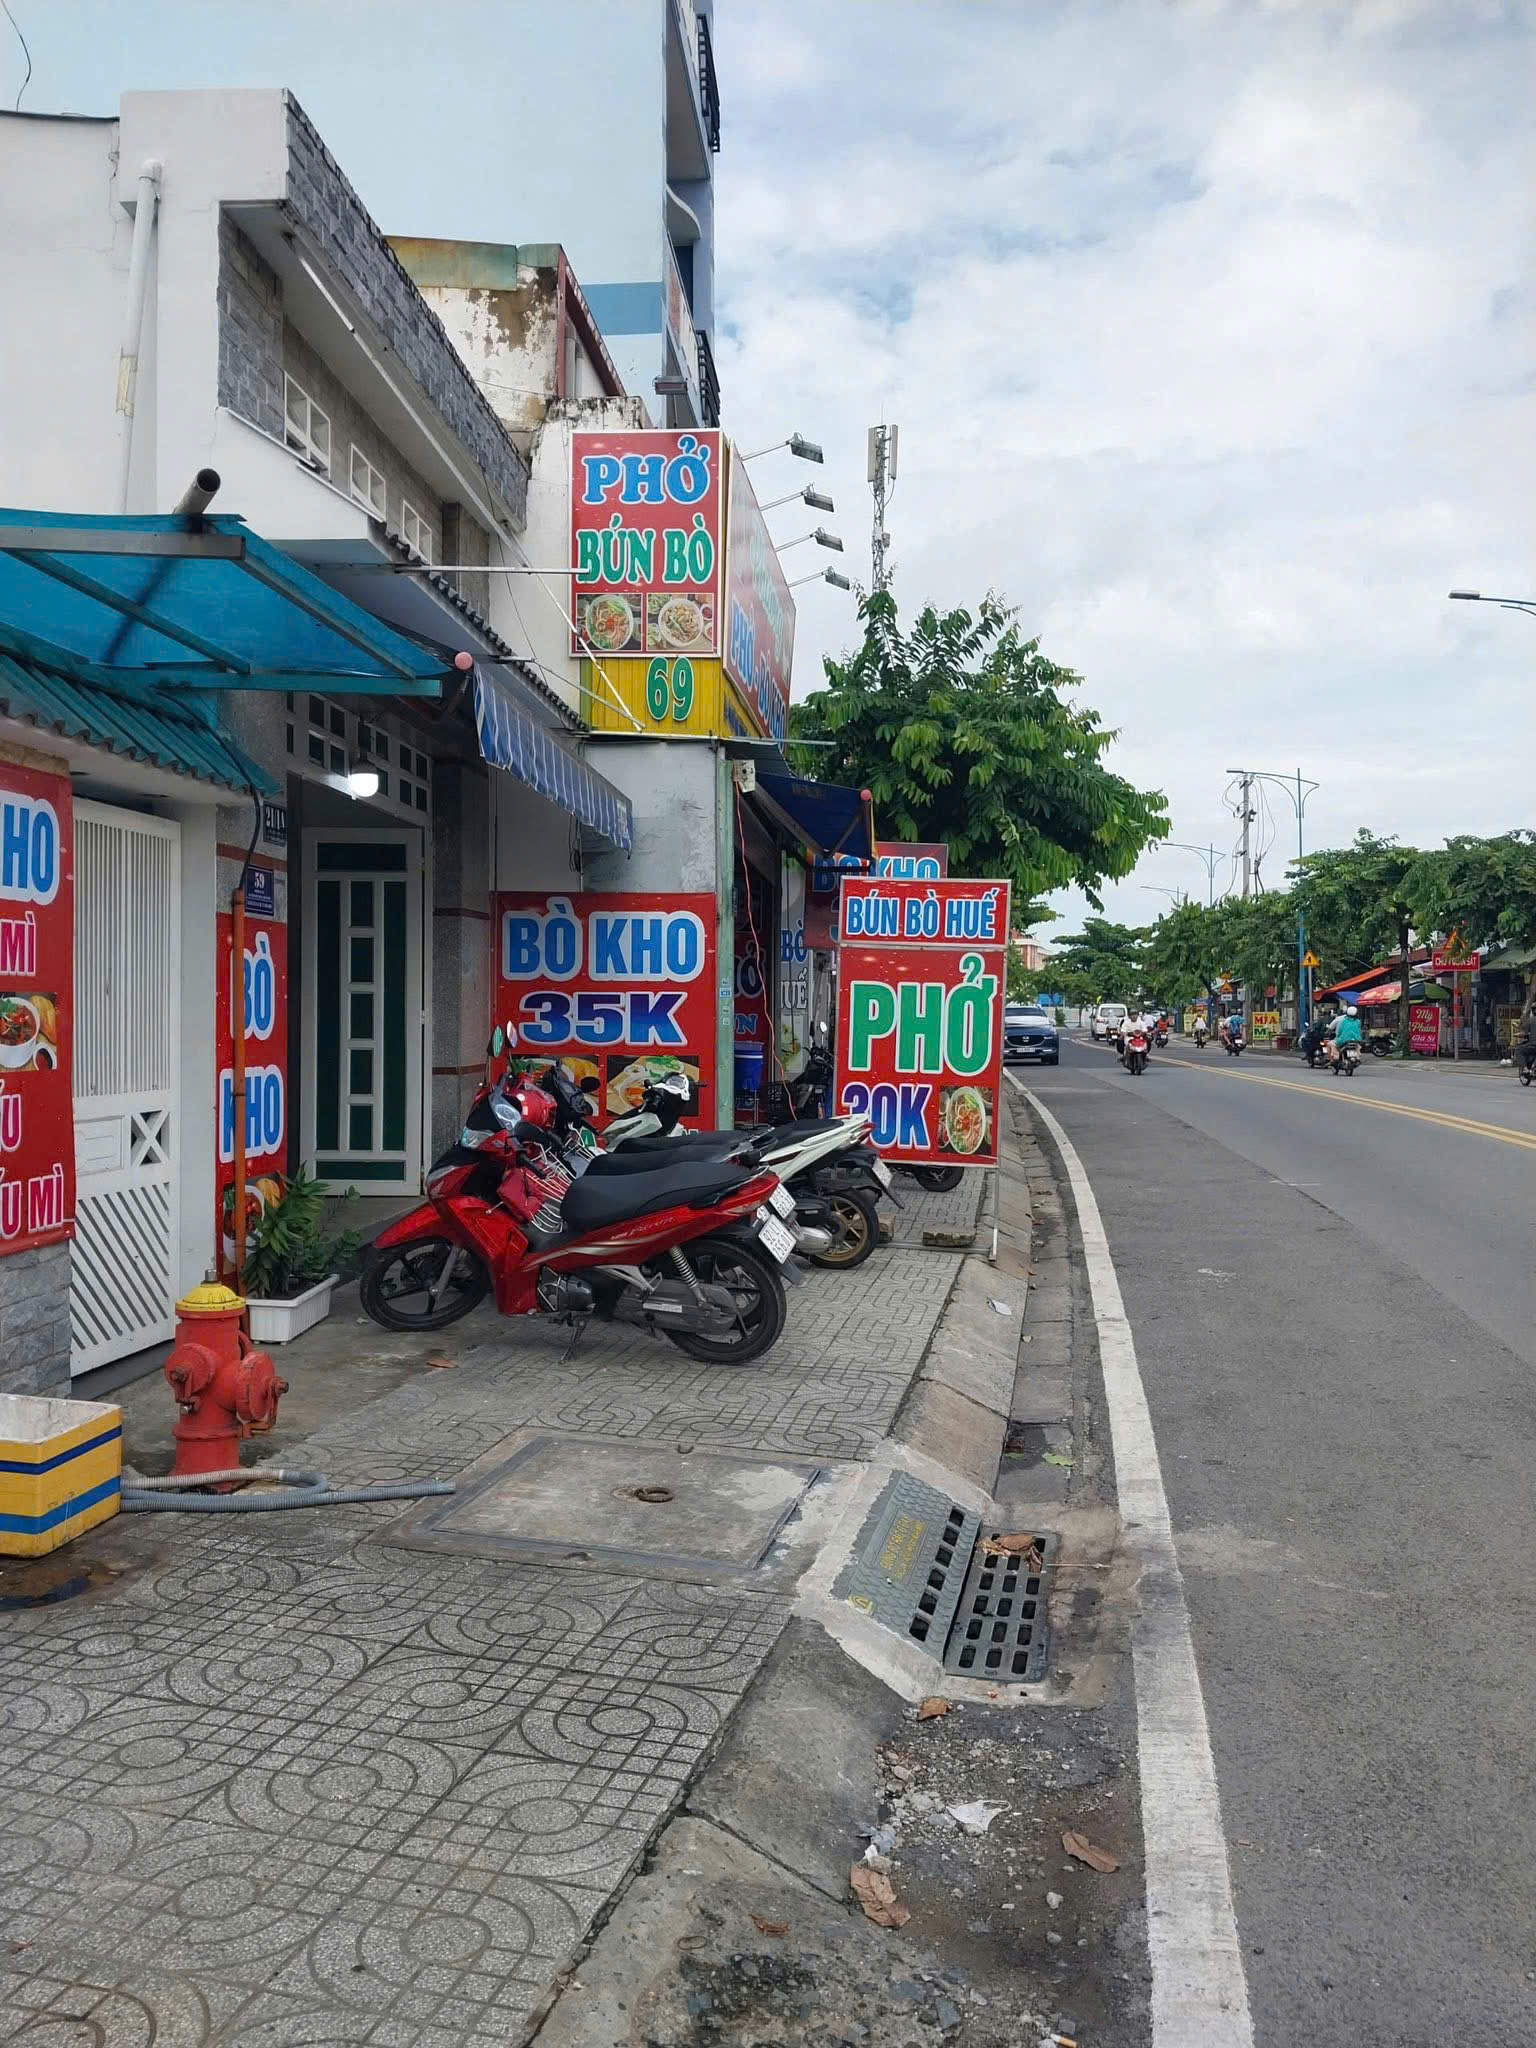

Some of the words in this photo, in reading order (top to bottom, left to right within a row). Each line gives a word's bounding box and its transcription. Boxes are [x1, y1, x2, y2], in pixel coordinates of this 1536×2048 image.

[584, 435, 710, 504] PHỞ
[577, 513, 654, 583] BÚN
[663, 513, 713, 583] BÒ
[647, 656, 694, 721] 69
[0, 800, 56, 897] HO
[254, 873, 266, 888] 59
[506, 900, 579, 978] BÒ
[592, 914, 702, 979] KHO
[847, 889, 903, 937] BÚN
[905, 889, 942, 938] BÒ
[945, 888, 999, 939] HUẾ
[520, 991, 687, 1046] 35K
[849, 953, 997, 1075] PHỞ
[842, 1084, 932, 1149] 30K
[28, 1163, 64, 1232] MÌ
